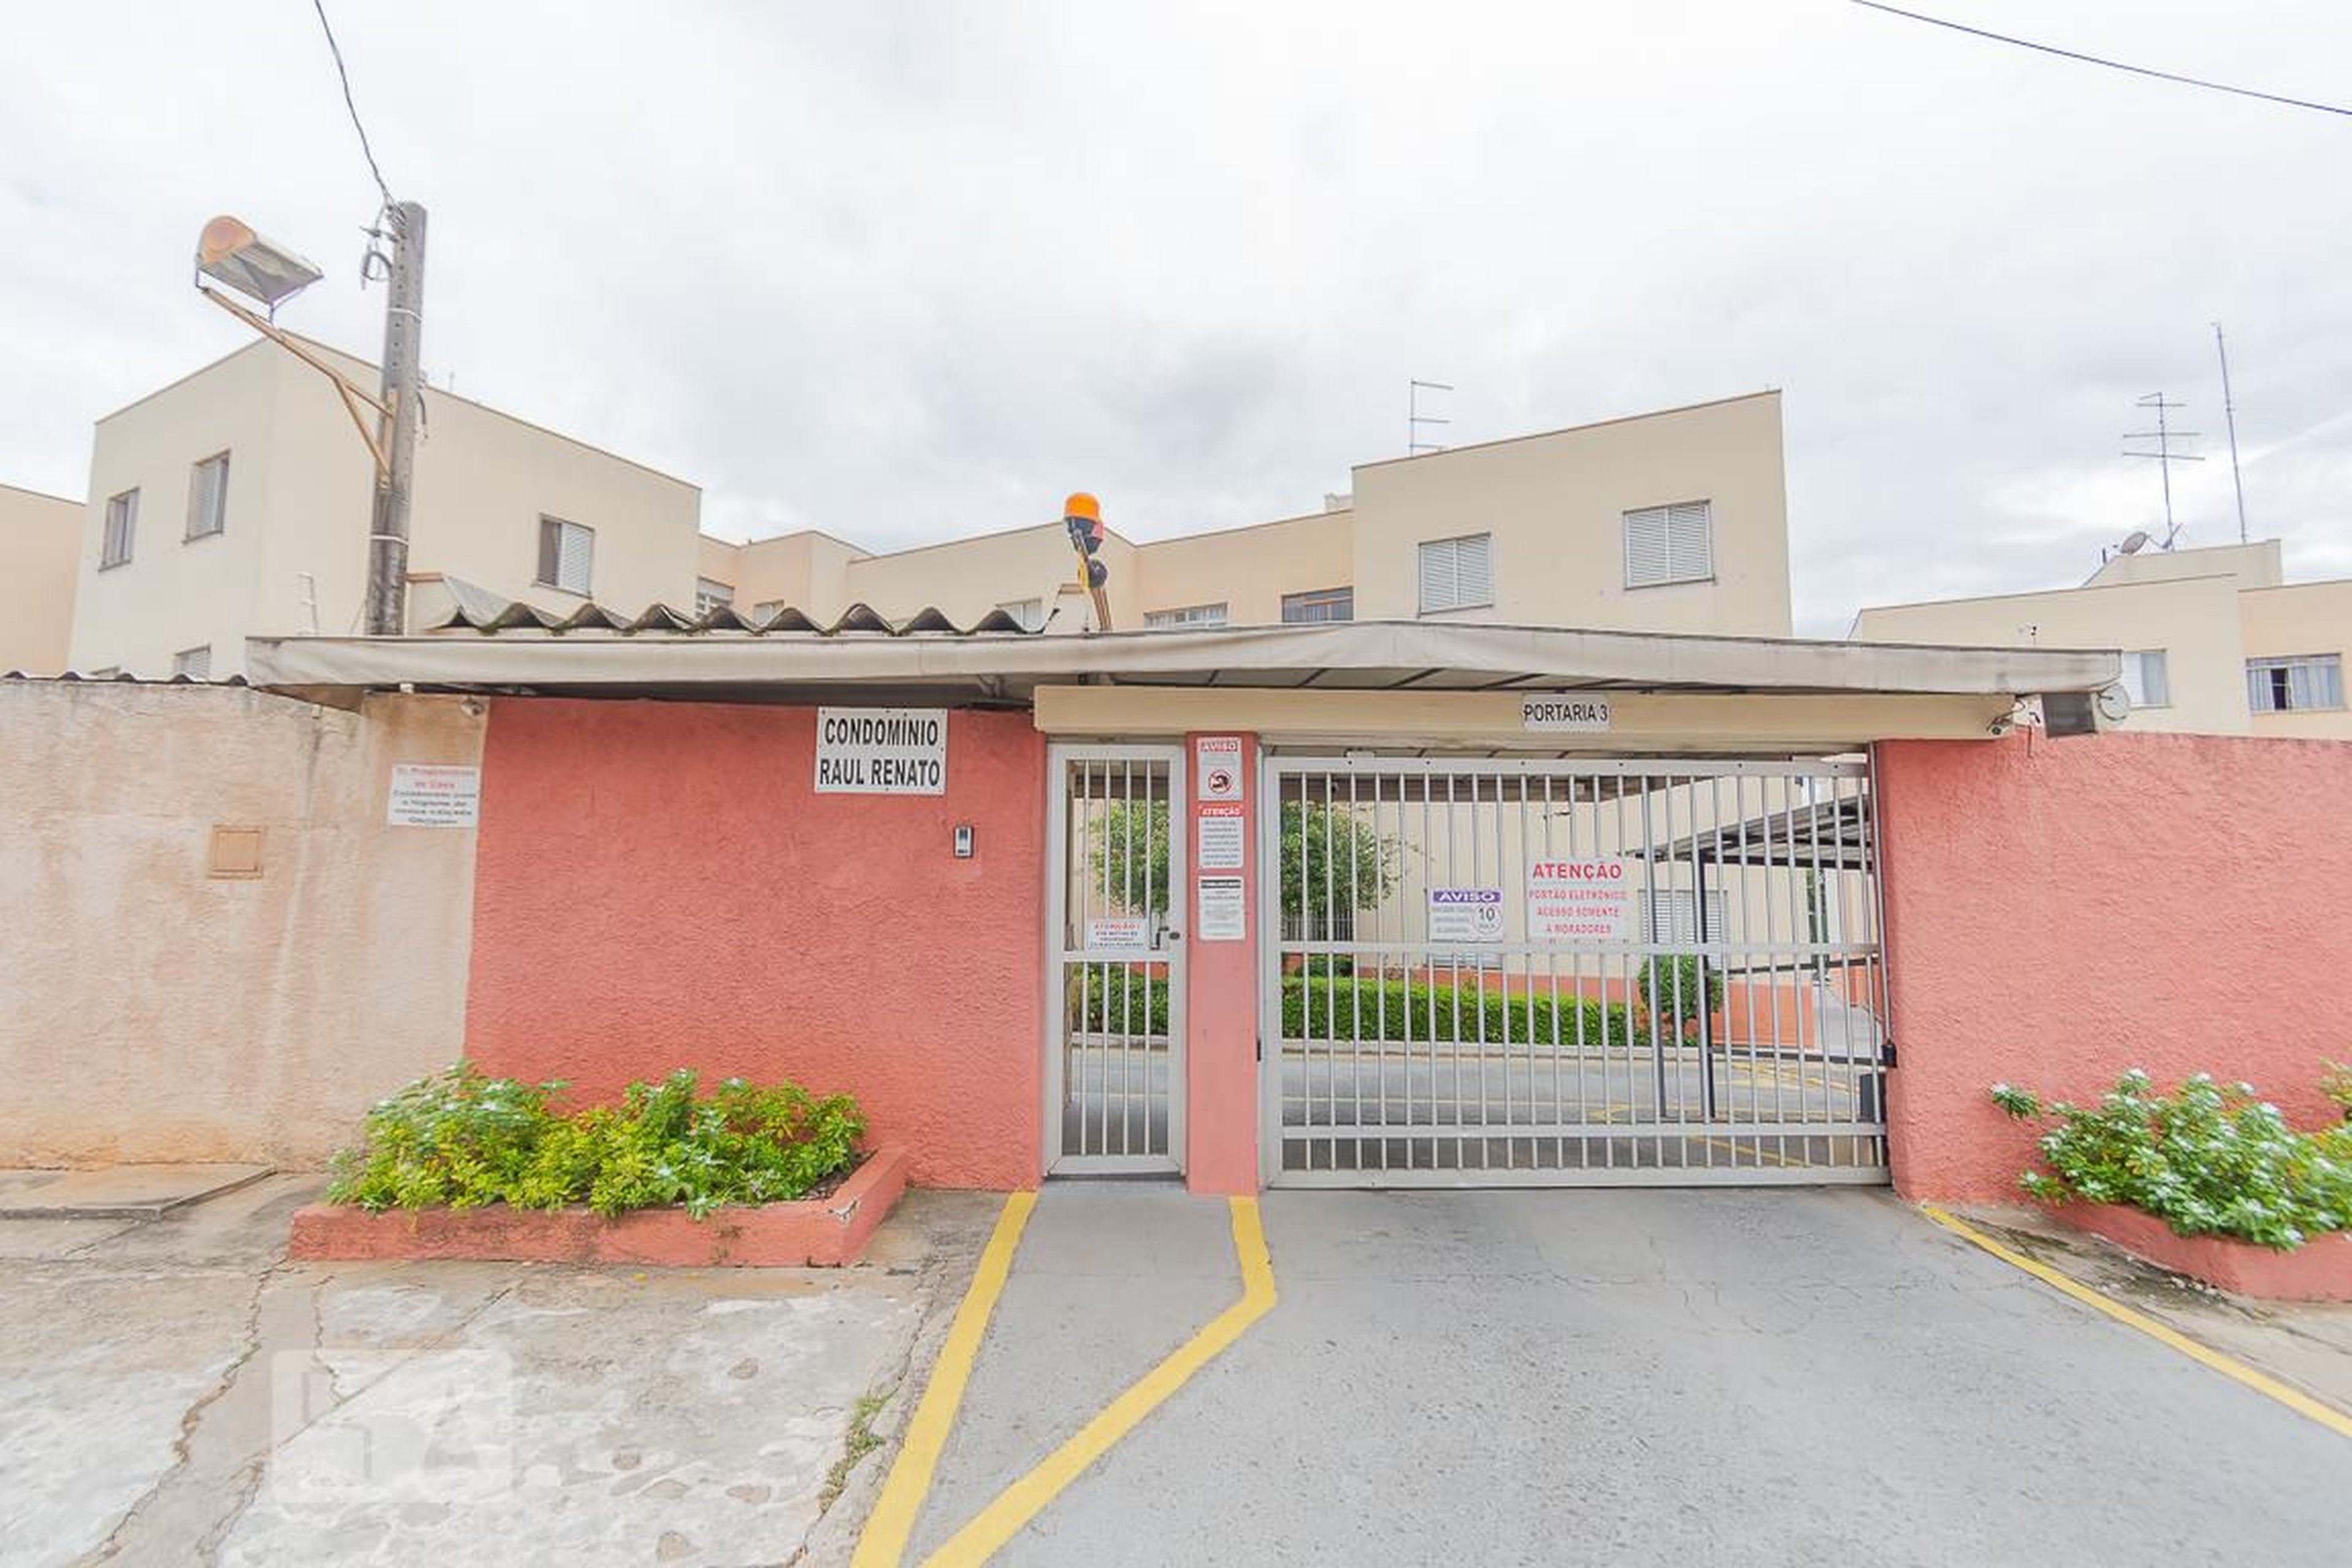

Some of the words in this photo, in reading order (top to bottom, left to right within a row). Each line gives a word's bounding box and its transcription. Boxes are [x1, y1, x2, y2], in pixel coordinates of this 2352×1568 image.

[1524, 704, 1597, 722] PORTARIA
[1600, 704, 1608, 722] 3
[820, 759, 865, 785] RAUL
[870, 759, 940, 786] RENATO
[1532, 861, 1622, 880] ATENÇÃO
[1439, 892, 1496, 902] AVISO
[1479, 907, 1496, 921] 10
